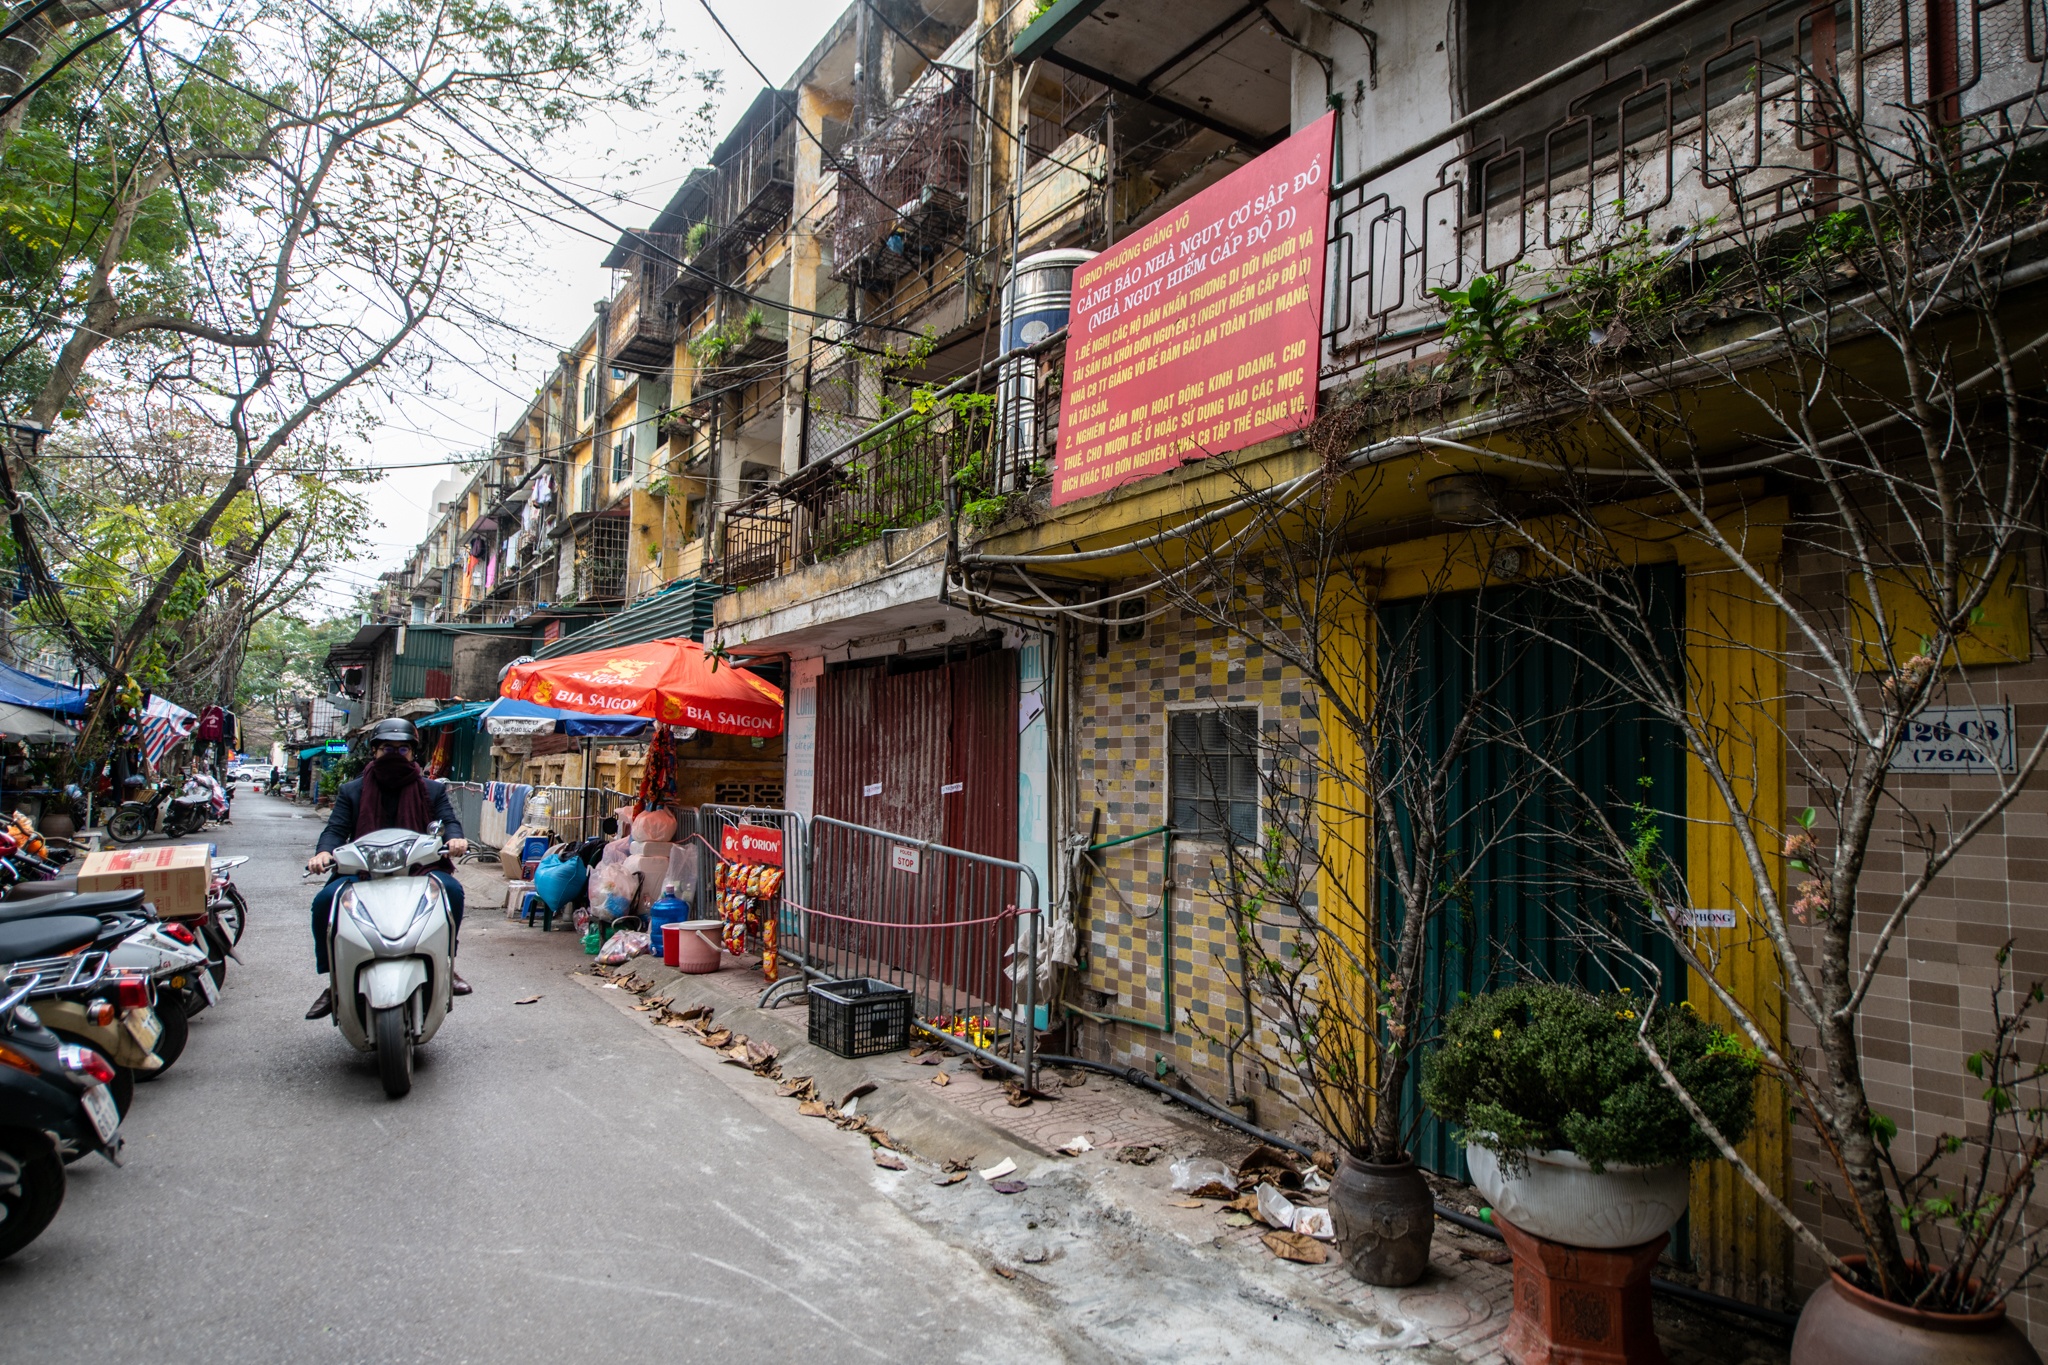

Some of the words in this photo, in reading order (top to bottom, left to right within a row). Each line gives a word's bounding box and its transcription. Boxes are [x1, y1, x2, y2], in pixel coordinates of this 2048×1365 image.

[1076, 282, 1113, 315] CẢNH
[1113, 266, 1142, 295] BÁO
[1143, 243, 1176, 279] NHÀ
[1178, 217, 1225, 259] NGUY
[1227, 199, 1252, 230] CƠ
[1253, 182, 1289, 217] SẬP
[1292, 153, 1321, 195] ĐỔ
[1079, 265, 1103, 290] UBND
[1103, 242, 1141, 276] PHƯỜNG
[1142, 223, 1173, 253] GIẢNG
[1175, 209, 1190, 233] VÕ
[1088, 297, 1121, 334] (NHÀ
[1122, 276, 1164, 313] NGUY
[1165, 252, 1208, 291] HIỂM
[1210, 230, 1243, 266] CẤP
[1245, 209, 1273, 248] ĐỘ
[1275, 205, 1297, 232] D)
[1091, 332, 1111, 354] NGHỊ
[1111, 323, 1129, 344] CÁC
[1129, 314, 1142, 336] HỘ
[1142, 306, 1161, 329] DÂN
[1162, 290, 1188, 319] KHẨN
[1228, 266, 1240, 286] DI
[1241, 254, 1260, 279] DỜI
[1261, 236, 1297, 269] NGƯỜI
[1298, 225, 1314, 250] VÀ
[1072, 365, 1085, 384] TÀI
[1084, 356, 1101, 378] SẢN
[1101, 353, 1113, 371] RA
[1113, 339, 1133, 365] KHỎI
[1133, 334, 1152, 356] ĐƠN
[1152, 316, 1189, 347] NGUYÊN
[1189, 312, 1197, 329] 3
[1197, 296, 1228, 327] (NGUY
[1228, 283, 1256, 310] HIỂM
[1257, 272, 1280, 296] CẤP
[1281, 260, 1297, 285] ĐỘ
[1298, 256, 1312, 277] D)
[1069, 384, 1086, 406] NHÀ
[1086, 381, 1098, 399] C8
[1098, 376, 1108, 394] TT
[1107, 365, 1134, 390] GIẢNG
[1134, 357, 1146, 378] VÕ
[1146, 347, 1160, 372] ĐỂ
[1159, 341, 1181, 367] ĐẢM
[1182, 330, 1202, 357] BẢO
[1202, 325, 1218, 347] AN
[1219, 312, 1247, 339] TOÀN
[1248, 300, 1273, 326] TÍNH
[1275, 283, 1310, 314] MẠNG
[1065, 435, 1073, 450] 2.
[1075, 421, 1107, 446] NGHIÊM
[1108, 409, 1128, 433] CẤM
[1130, 403, 1149, 425] MỌI
[1151, 392, 1175, 416] HOẠT
[1177, 380, 1205, 406] ĐỘNG
[1207, 368, 1234, 394] KINH
[1236, 351, 1277, 382] DOANH,
[1282, 338, 1307, 364] CHO
[1063, 449, 1084, 472] THUÊ,
[1085, 444, 1103, 463] CHO
[1103, 434, 1129, 457] MƯỢN
[1130, 423, 1144, 447] ĐỂ
[1144, 419, 1153, 442] Ở
[1153, 415, 1179, 439] HOẶC
[1180, 403, 1196, 429] SỬ
[1196, 397, 1225, 423] DỤNG
[1227, 388, 1249, 411] VÀO
[1251, 378, 1274, 402] CÁC
[1277, 366, 1305, 393] MỤC
[1068, 409, 1078, 428] VÀ
[1078, 404, 1091, 423] TÀI
[1090, 395, 1109, 418] SẢN.
[1061, 475, 1079, 494] ĐÍCH
[1079, 467, 1100, 488] KHÁC
[1101, 463, 1114, 482] TẠI
[1114, 456, 1132, 476] ĐƠN
[1132, 443, 1168, 470] NGUYÊN
[1168, 441, 1175, 458] 3
[1175, 430, 1196, 455] NHÀ
[1197, 428, 1211, 447] C8
[1212, 420, 1231, 444] TẬP
[1233, 406, 1254, 435] THỂ
[1253, 399, 1288, 428] GIẢNG
[569, 671, 636, 685] SAIGON
[555, 690, 584, 705] BIA
[588, 693, 641, 710] SAIGON
[796, 687, 815, 716] LOAN
[687, 706, 713, 722] BIA
[717, 711, 773, 729] SAIGON
[1958, 720, 2000, 742] C8
[1914, 749, 1985, 764] (76A)
[751, 838, 778, 853] ORION
[899, 849, 912, 857] POLICE
[897, 857, 914, 868] STOP
